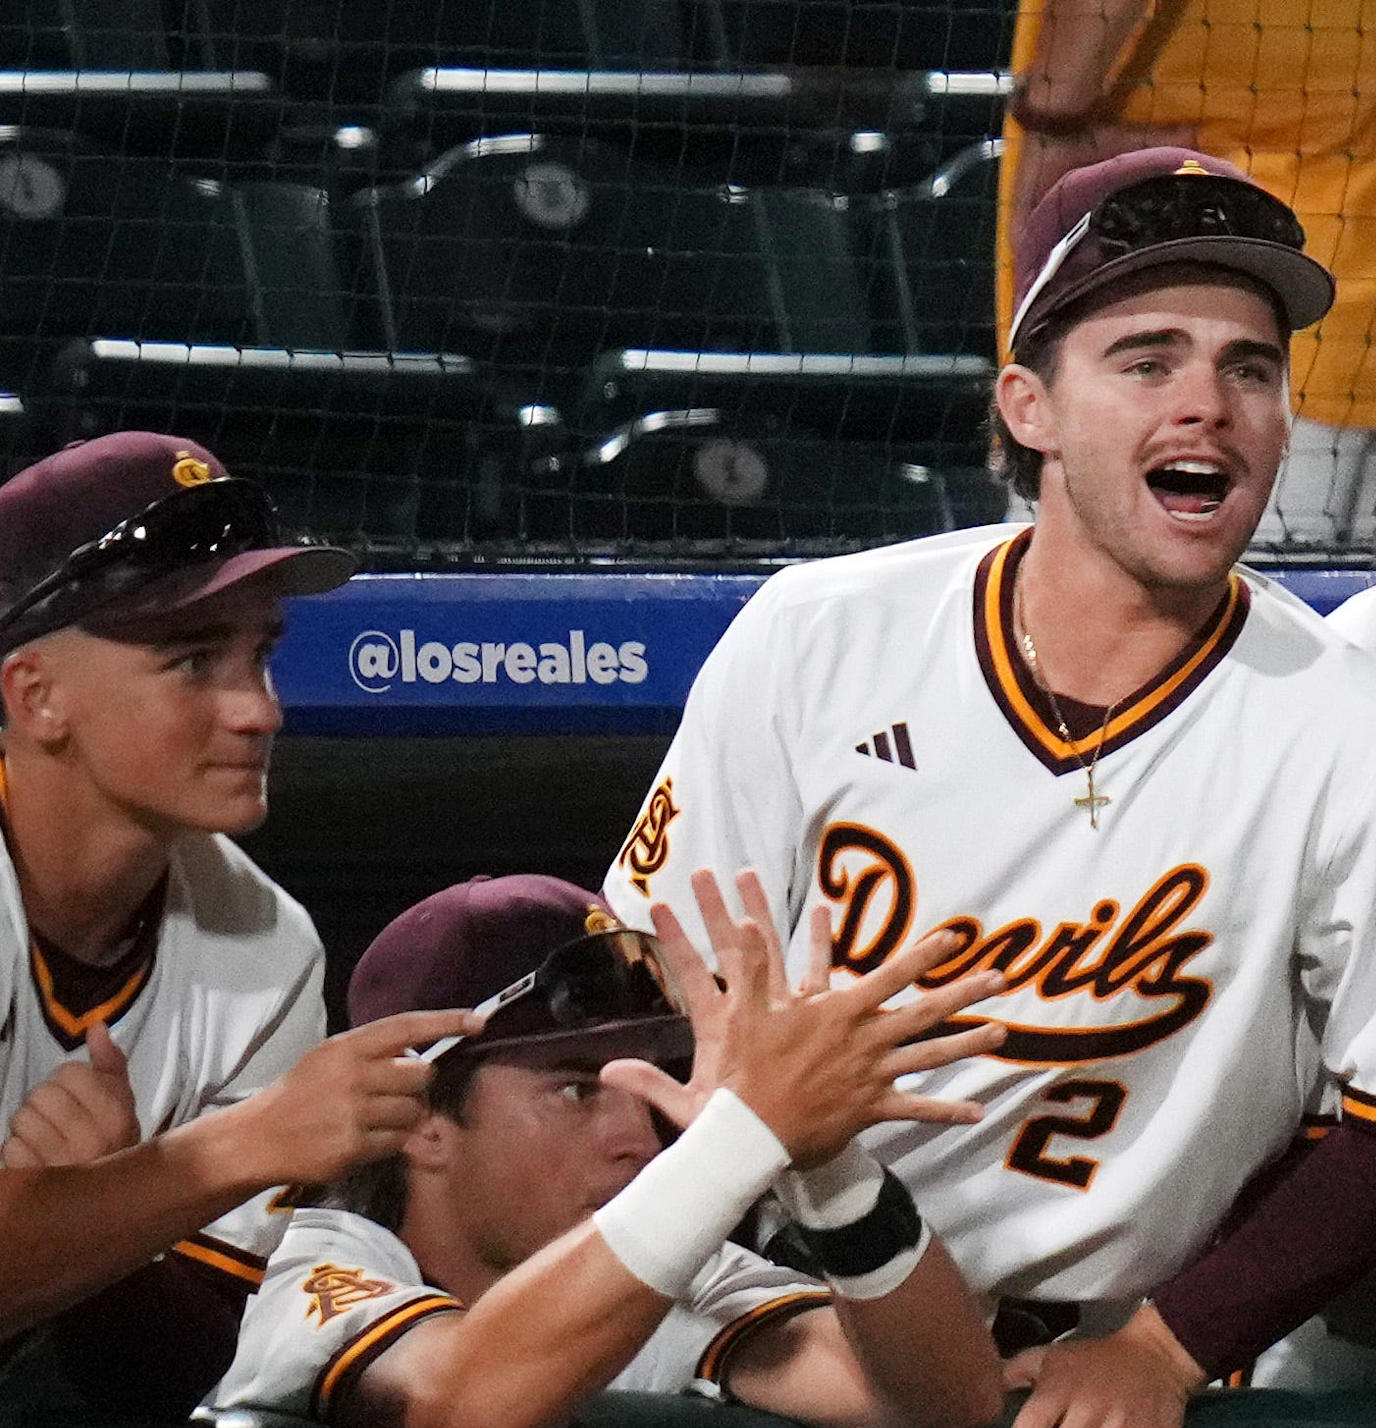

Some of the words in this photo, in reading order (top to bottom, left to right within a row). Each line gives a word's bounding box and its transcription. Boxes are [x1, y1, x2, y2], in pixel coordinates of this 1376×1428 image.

[349, 629, 648, 693] @losreales
[818, 821, 1215, 1002] Devils
[1006, 1080, 1127, 1191] 2
